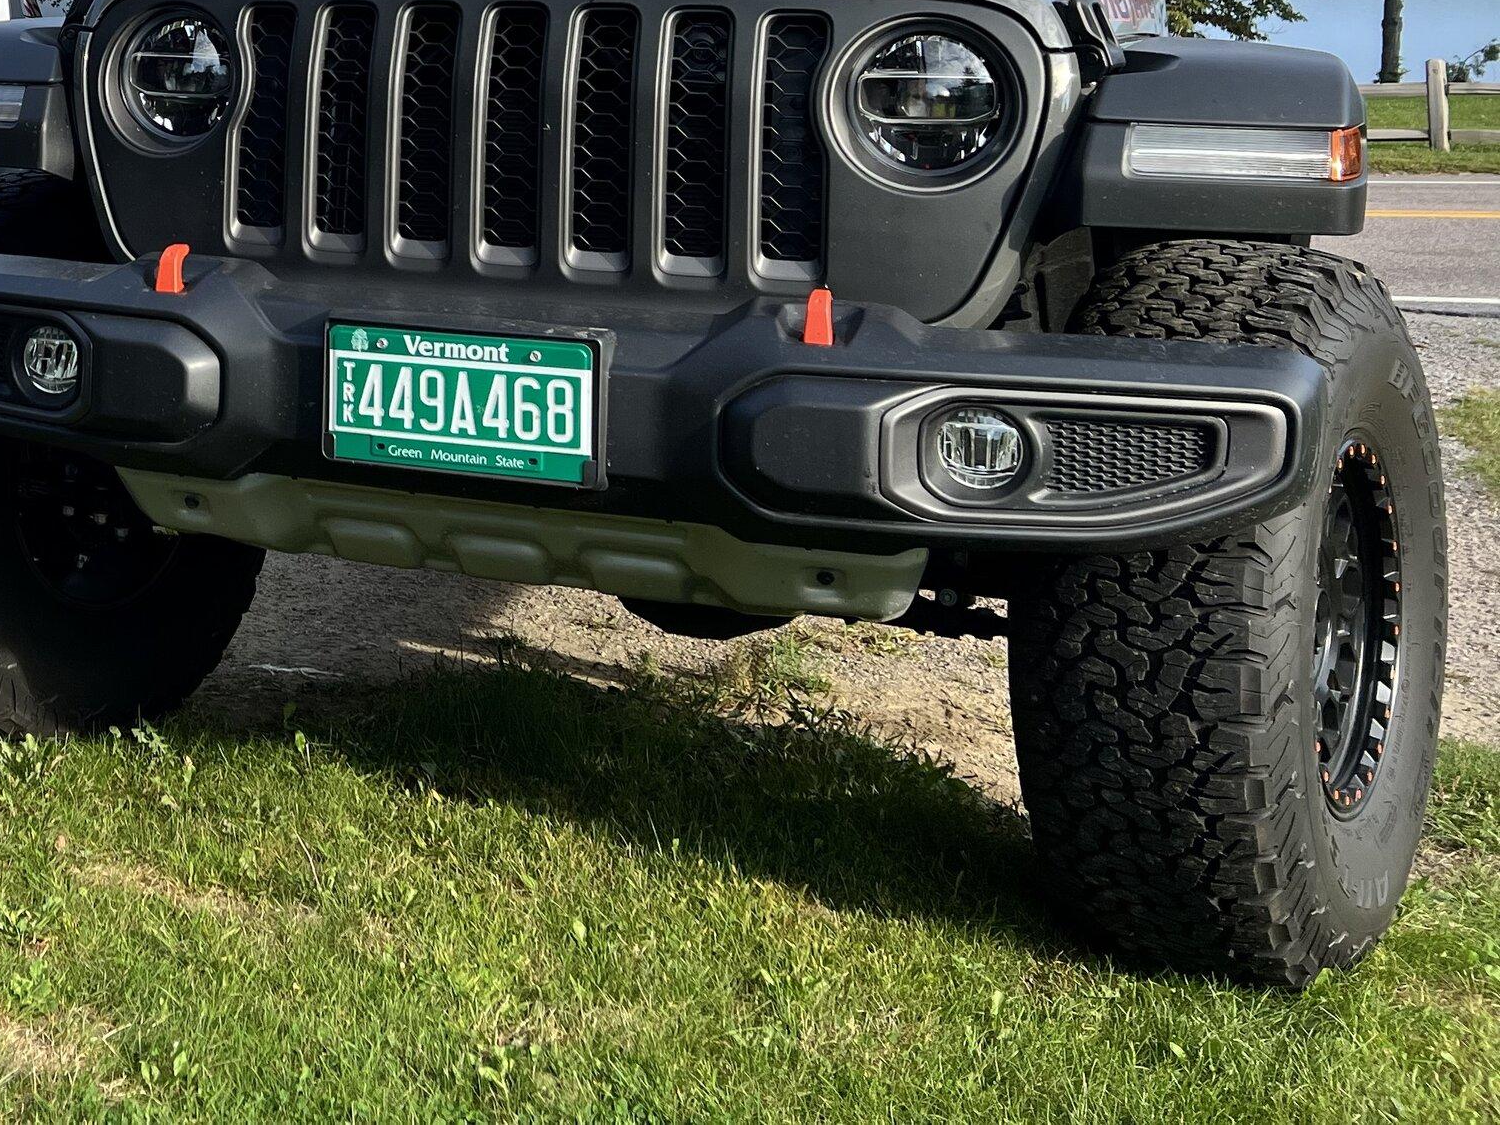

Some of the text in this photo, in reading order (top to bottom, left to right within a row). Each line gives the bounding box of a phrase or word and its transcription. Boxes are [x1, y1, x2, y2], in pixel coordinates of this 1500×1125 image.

[403, 334, 509, 363] Vermont
[342, 361, 356, 424] TRK
[358, 363, 575, 444] 449A468
[388, 445, 525, 470] Green Mountain State
